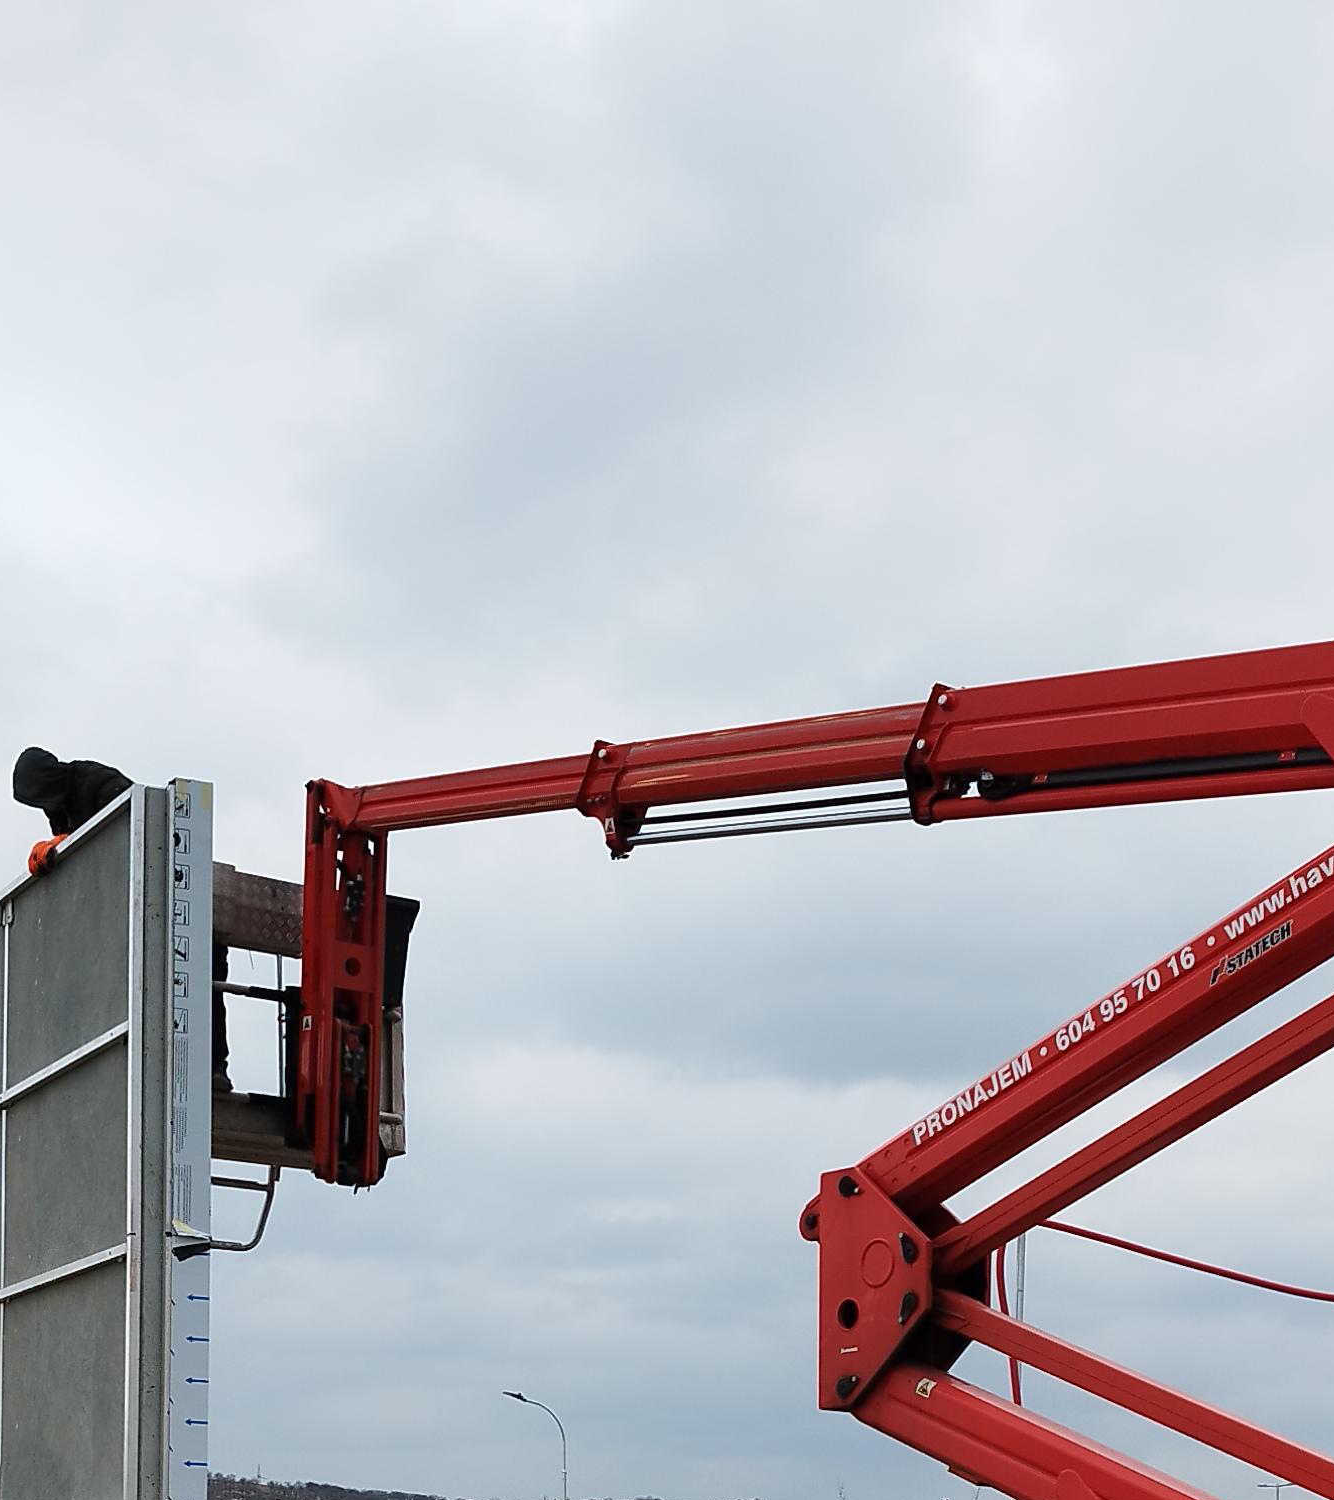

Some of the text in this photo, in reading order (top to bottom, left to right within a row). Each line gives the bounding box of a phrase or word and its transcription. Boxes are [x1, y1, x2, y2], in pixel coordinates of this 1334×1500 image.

[1226, 920, 1293, 976] STATECH
[1055, 1011, 1096, 1051] 604
[1099, 989, 1128, 1023] 95
[1132, 968, 1161, 1001] 70
[1167, 946, 1196, 978] 16
